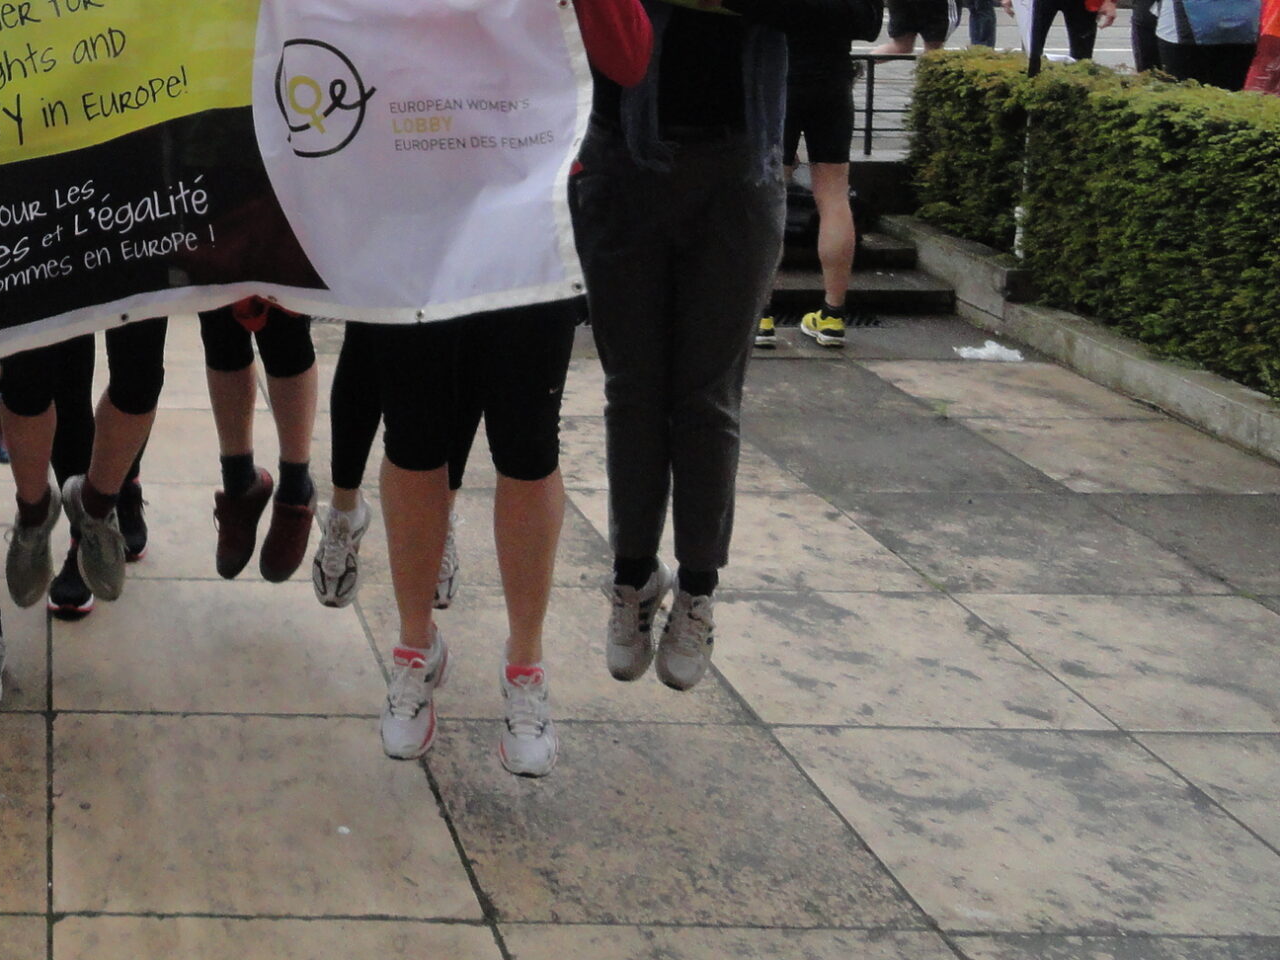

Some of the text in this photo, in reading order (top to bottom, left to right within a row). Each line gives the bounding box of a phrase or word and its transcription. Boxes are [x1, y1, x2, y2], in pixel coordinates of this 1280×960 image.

[41, 97, 69, 129] in
[389, 97, 530, 114] EUROPEAN WOMEN'S
[392, 116, 453, 133] LOBBY
[470, 136, 497, 149] DES
[500, 130, 555, 149] FEMMES
[41, 225, 64, 248] et
[84, 246, 111, 270] en
